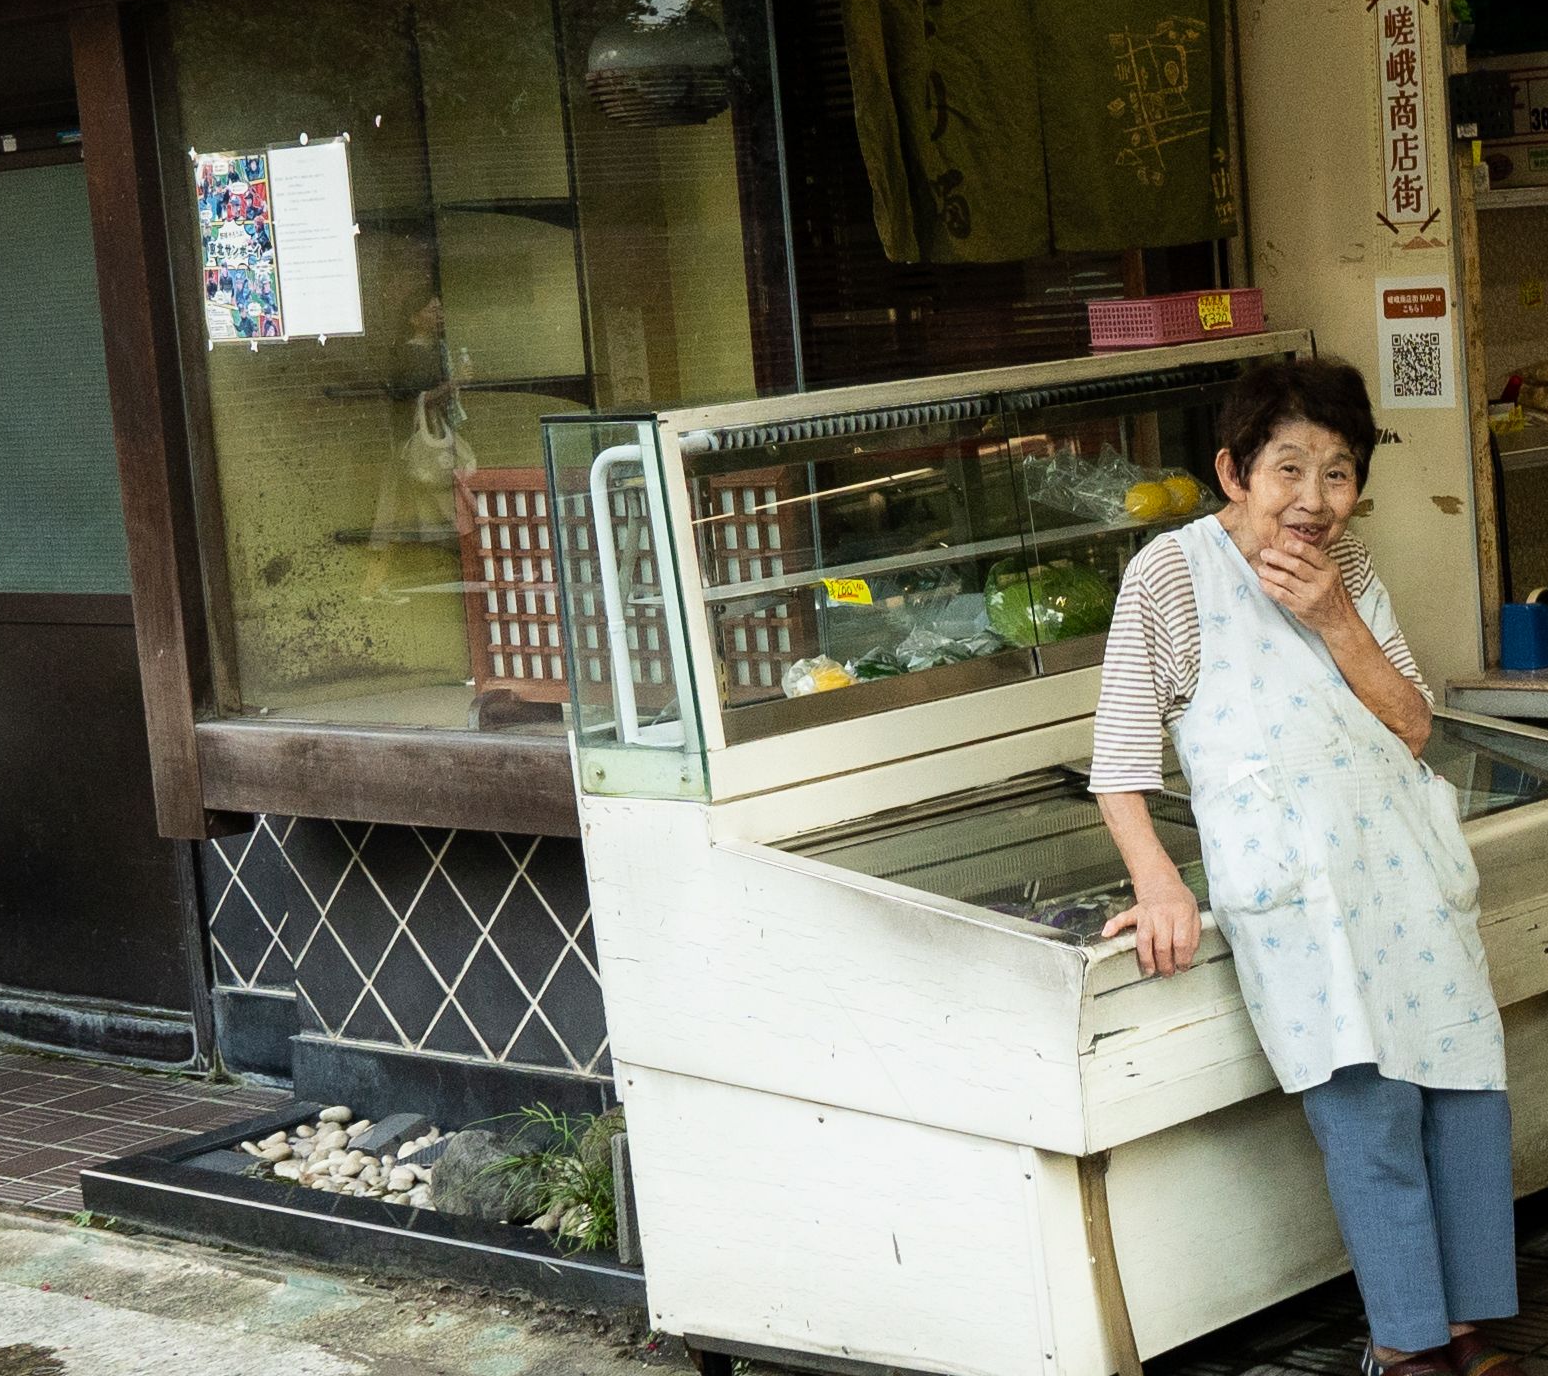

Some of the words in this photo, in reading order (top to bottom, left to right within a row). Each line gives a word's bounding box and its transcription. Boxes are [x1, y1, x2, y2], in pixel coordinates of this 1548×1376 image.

[1384, 5, 1424, 214] 嵯峨商店街
